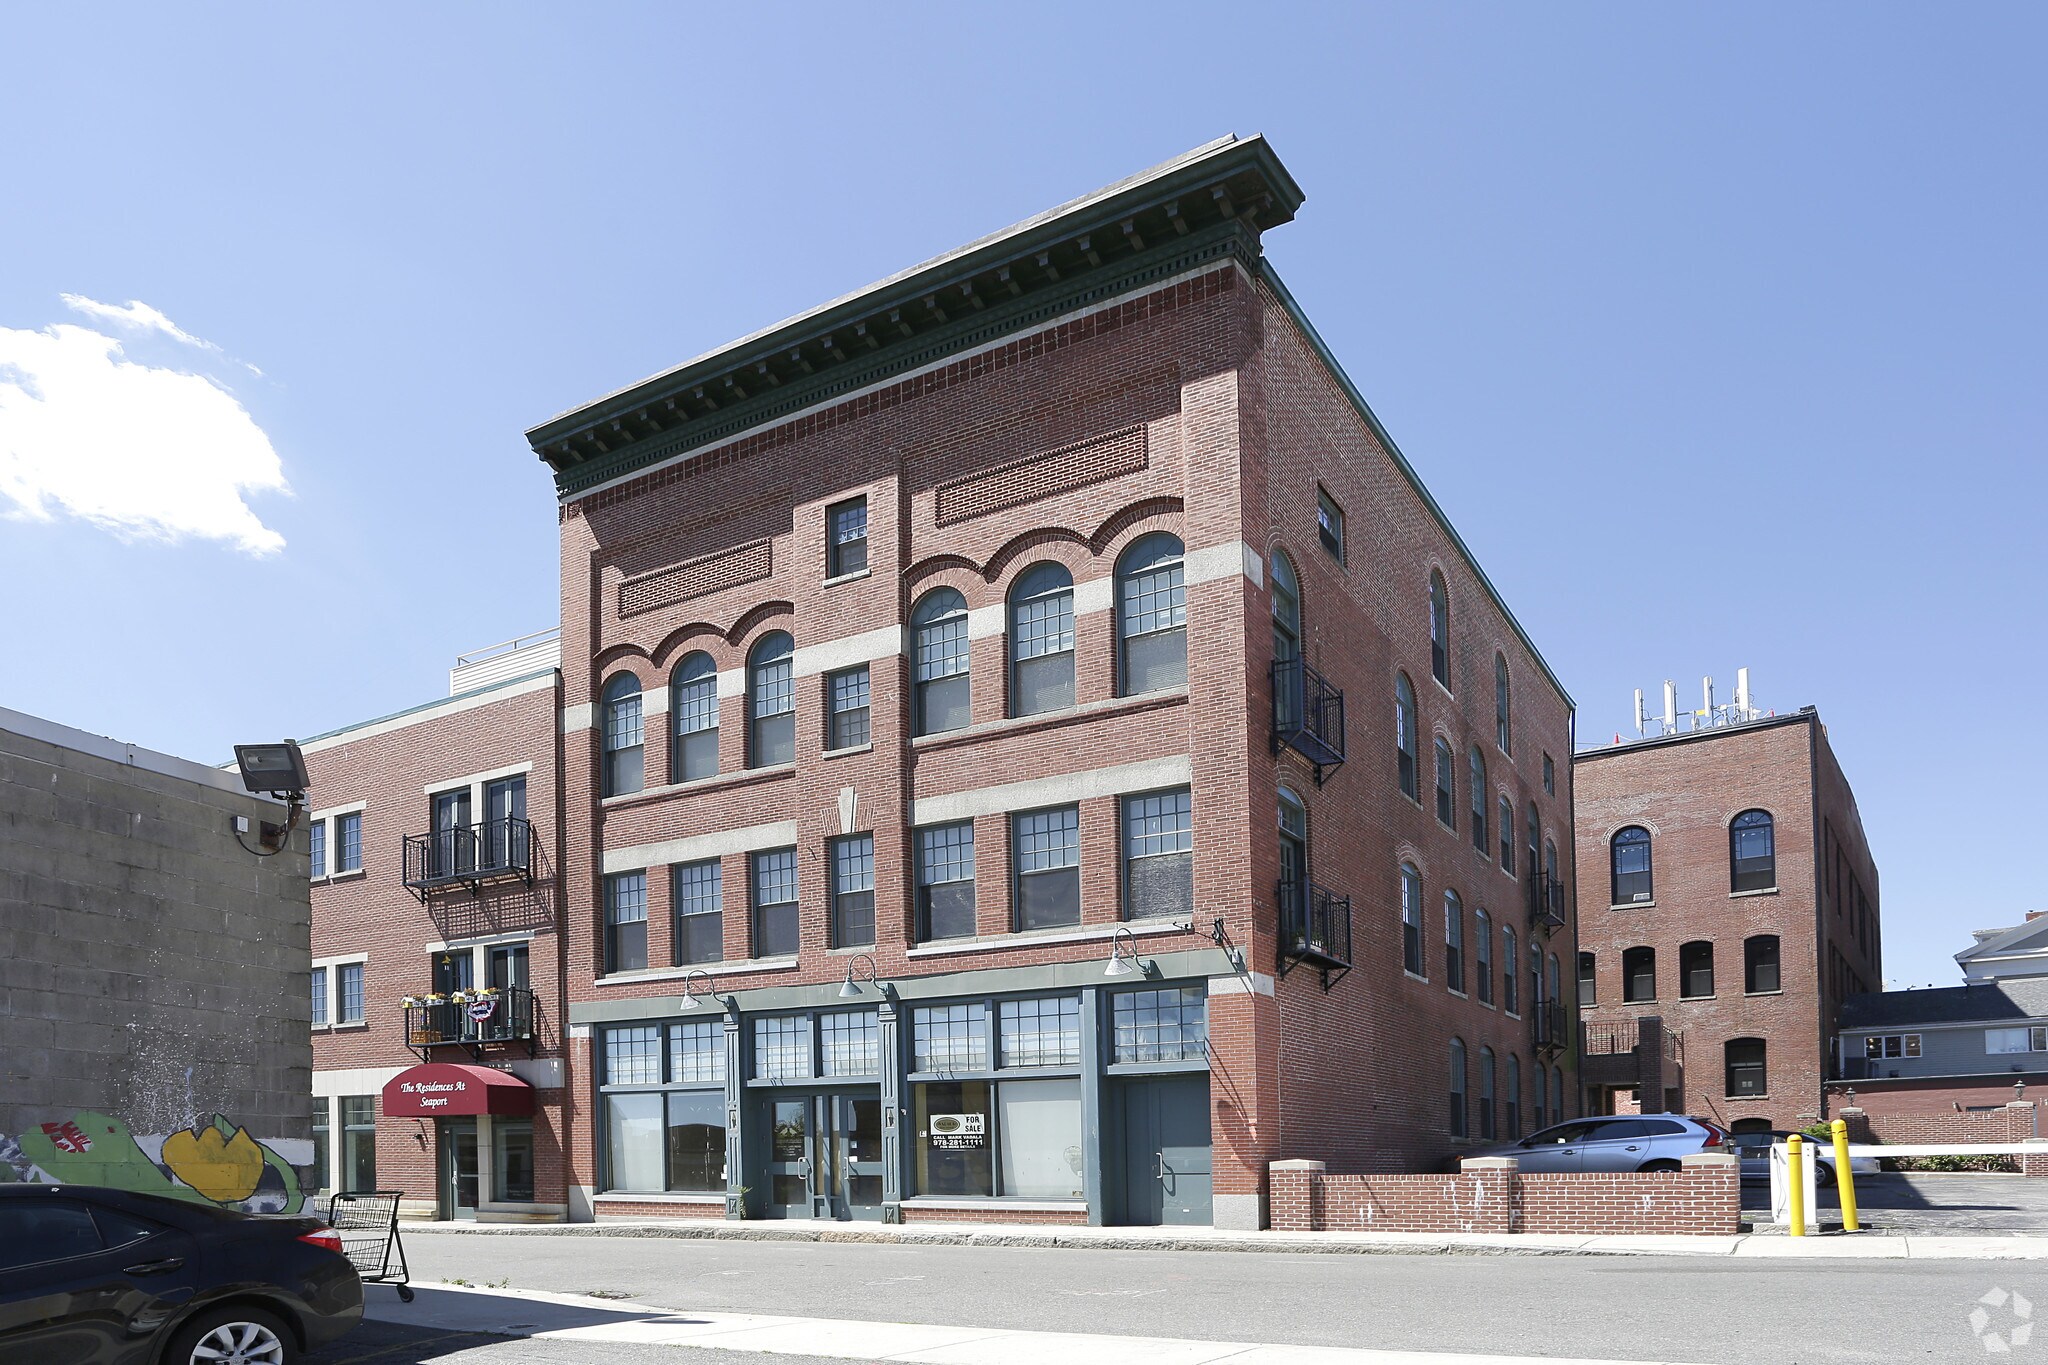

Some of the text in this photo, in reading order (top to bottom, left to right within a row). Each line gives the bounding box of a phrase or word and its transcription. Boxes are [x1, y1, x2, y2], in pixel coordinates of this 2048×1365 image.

[400, 1081, 466, 1094] The Residences At
[420, 1096, 448, 1109] Seaport
